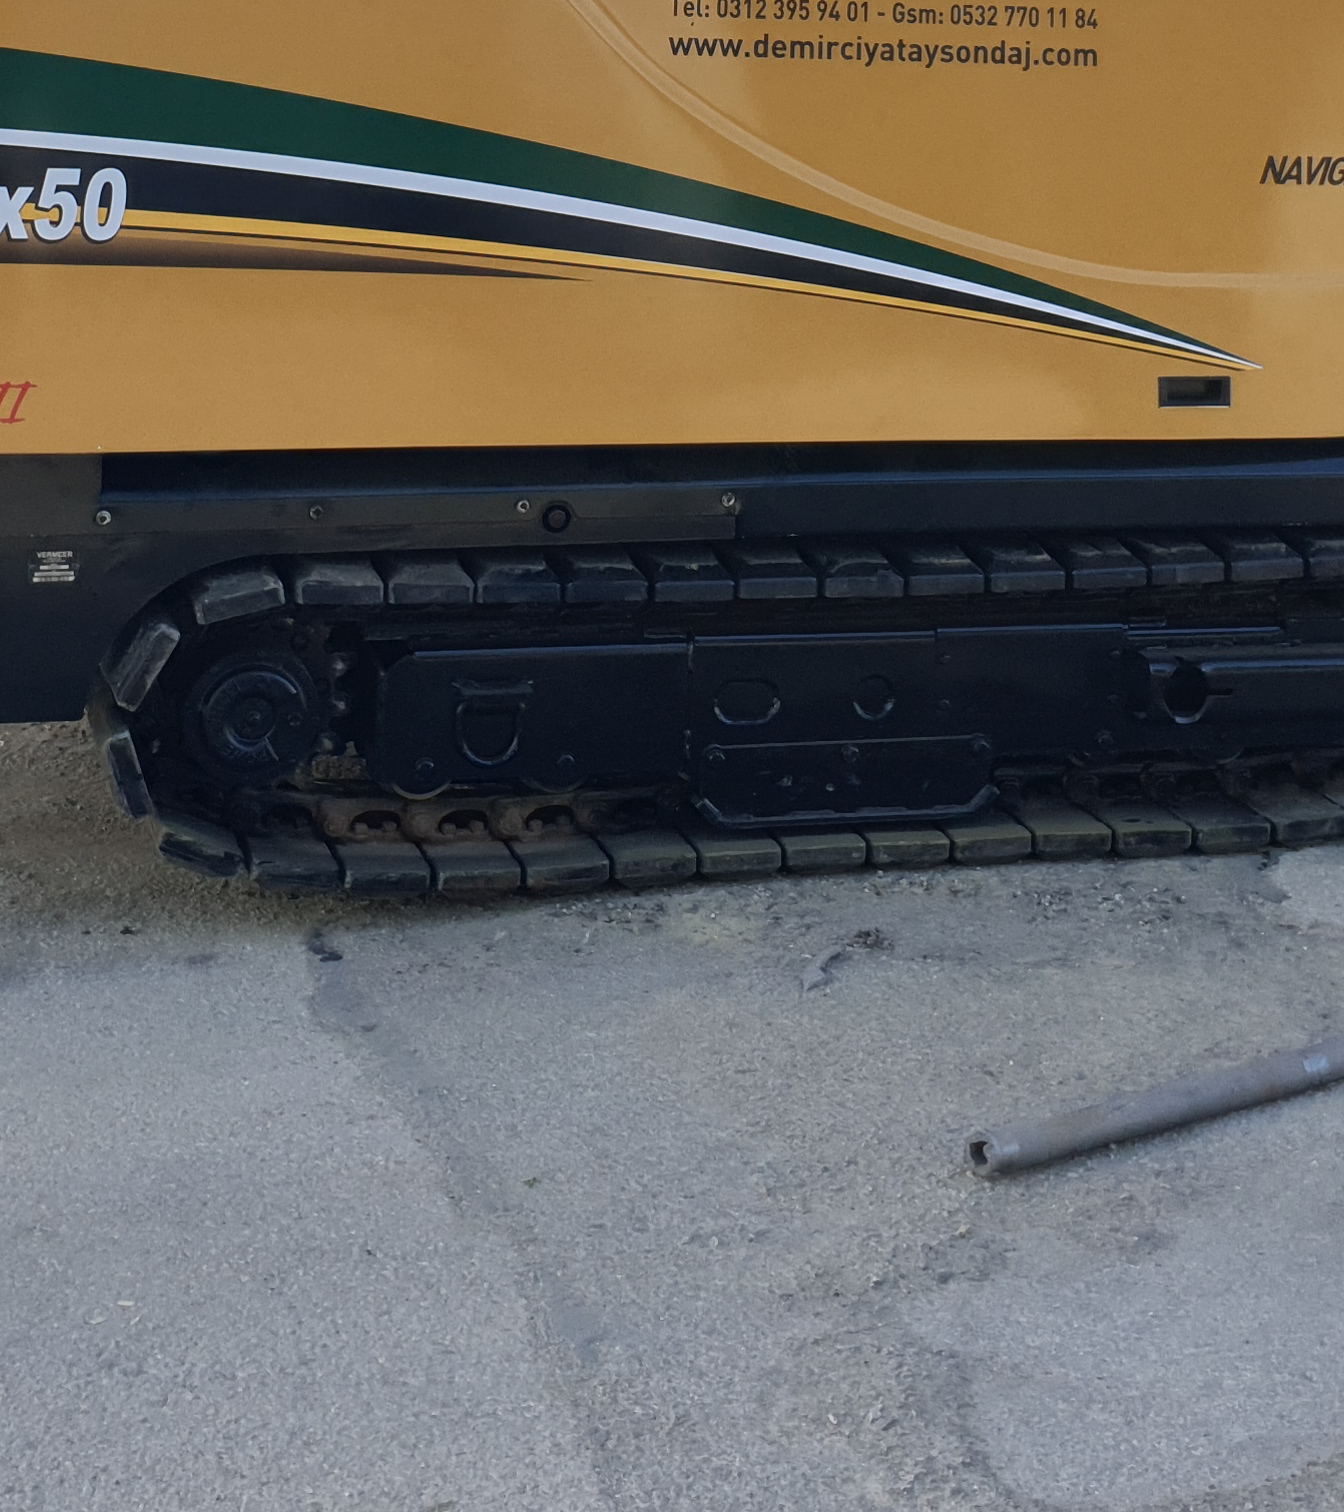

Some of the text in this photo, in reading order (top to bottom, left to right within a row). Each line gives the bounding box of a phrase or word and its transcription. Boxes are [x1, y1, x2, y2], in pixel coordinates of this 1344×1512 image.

[816, 0, 841, 22] 94
[846, 0, 869, 23] 01
[892, 2, 944, 25] Gsm:
[950, 3, 998, 26] 0532
[1004, 5, 1040, 28] 770
[1047, 6, 1068, 29] 11
[1074, 7, 1099, 30] 84
[668, 33, 1098, 72] www.demirciyataysondaj.com
[37, 551, 74, 559] VERMEER
